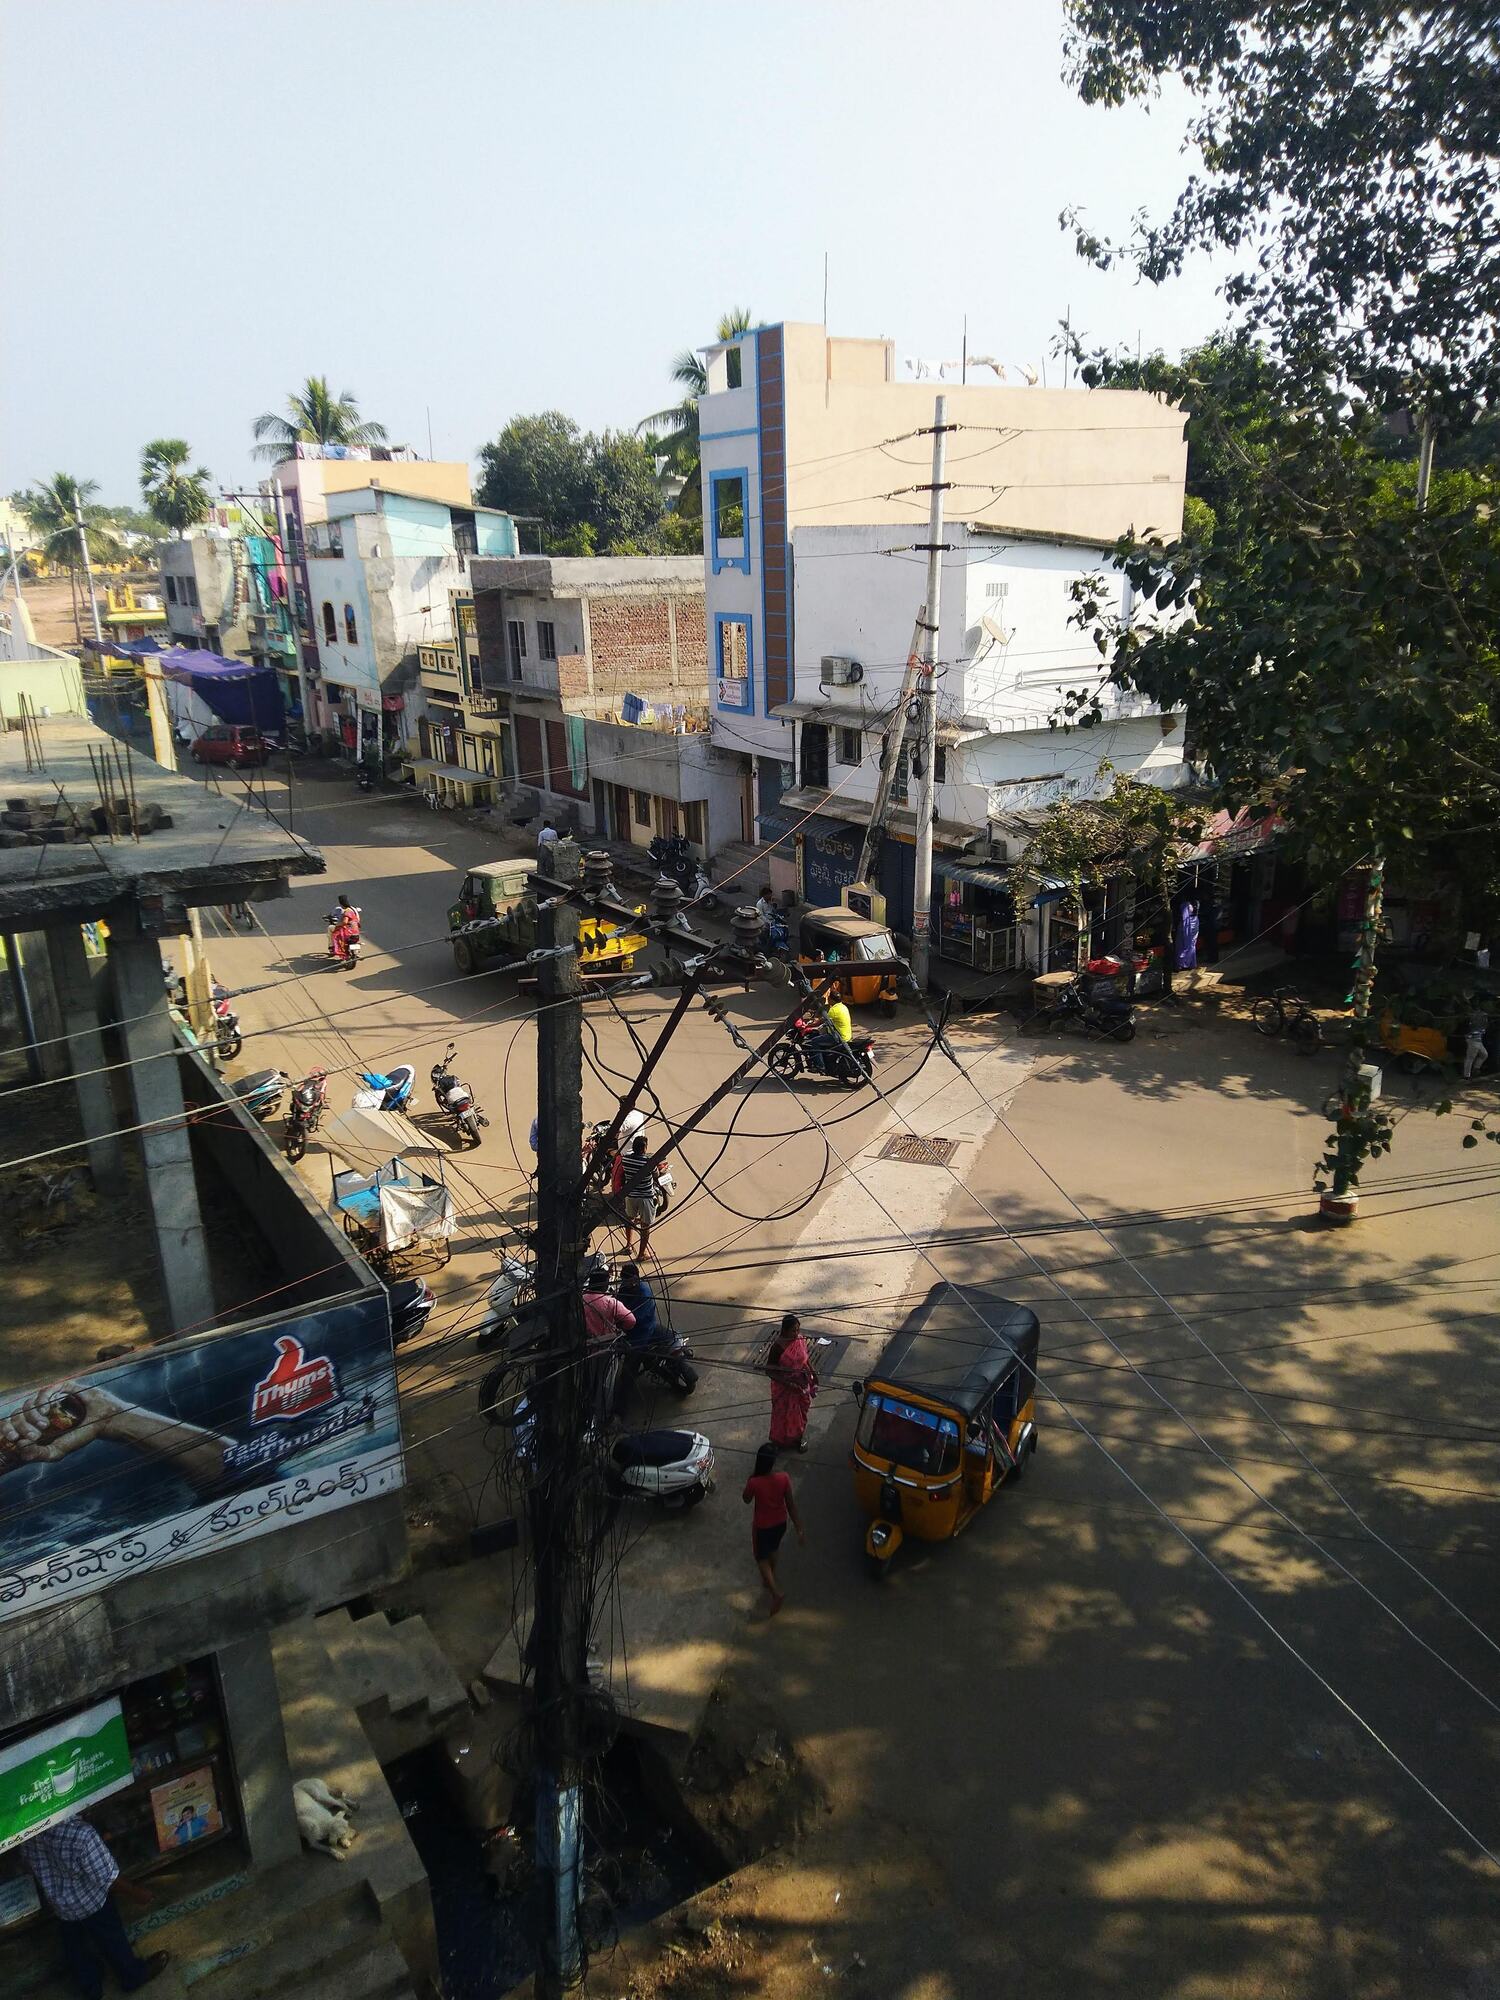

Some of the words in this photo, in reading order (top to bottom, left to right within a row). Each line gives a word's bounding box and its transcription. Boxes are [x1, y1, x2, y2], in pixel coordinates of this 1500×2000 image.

[257, 1366, 329, 1408] Thums
[223, 1431, 283, 1464] Taste
[170, 1530, 191, 1548] &
